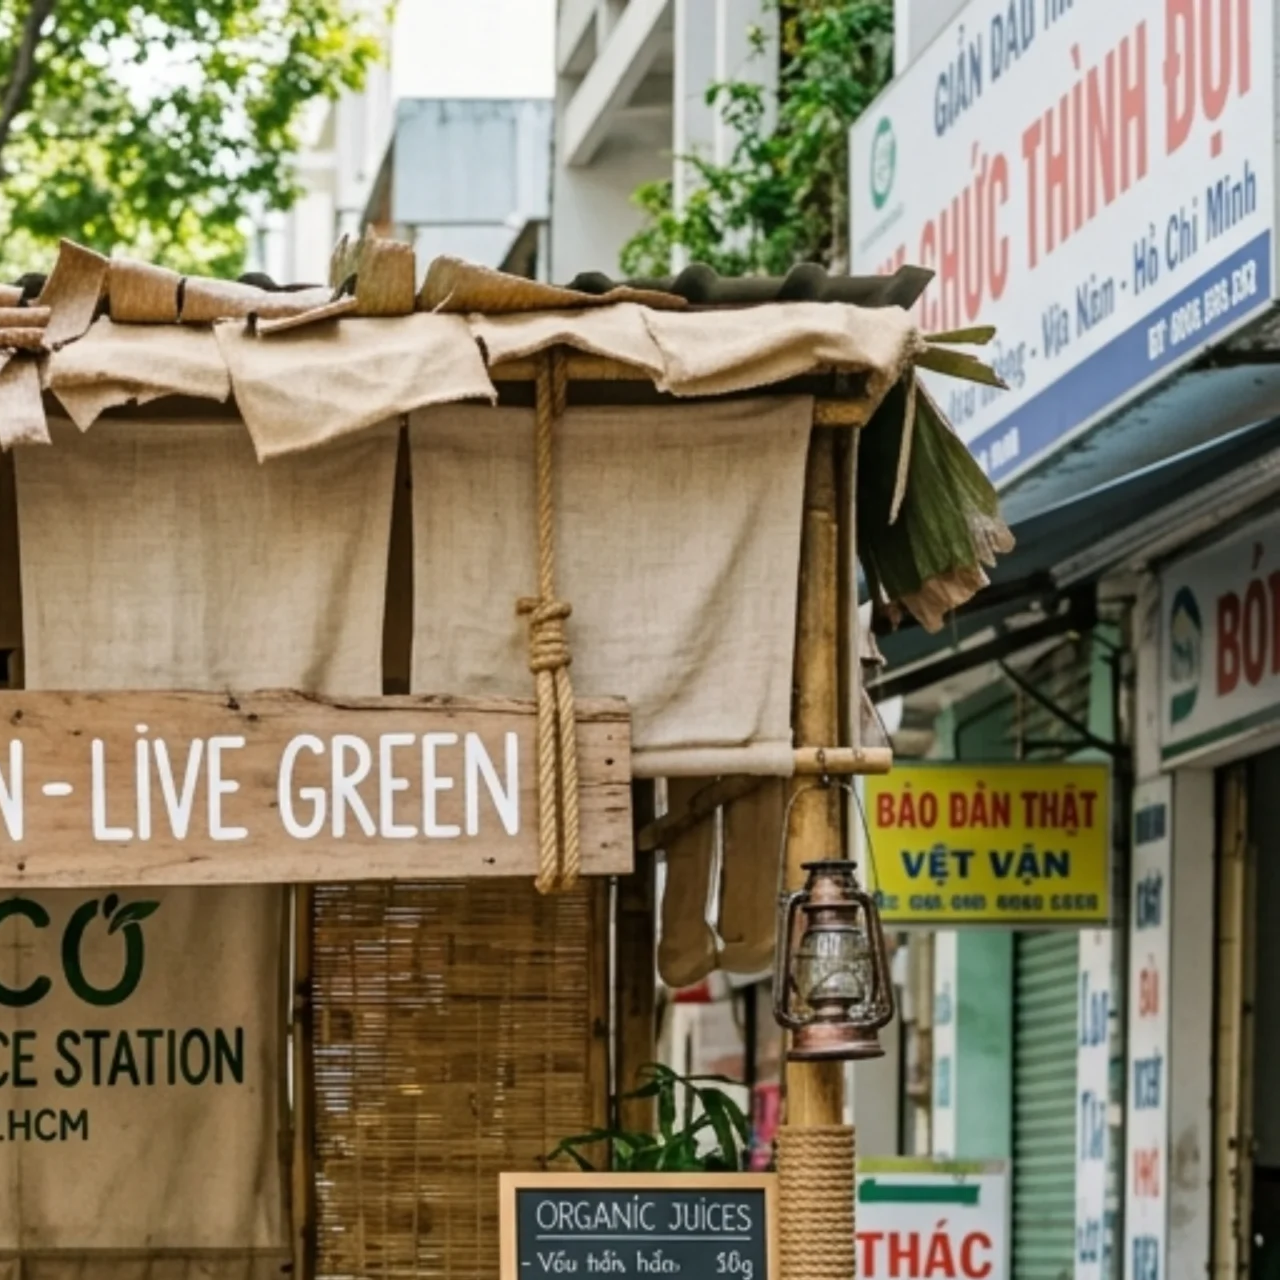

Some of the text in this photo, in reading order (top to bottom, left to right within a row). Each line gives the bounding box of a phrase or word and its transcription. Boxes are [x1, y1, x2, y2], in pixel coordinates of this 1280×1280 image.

[1216, 541, 1280, 698] BÓ
[277, 731, 520, 840] GREEN
[54, 1027, 244, 1088] STATION
[855, 1219, 993, 1280] THÁC
